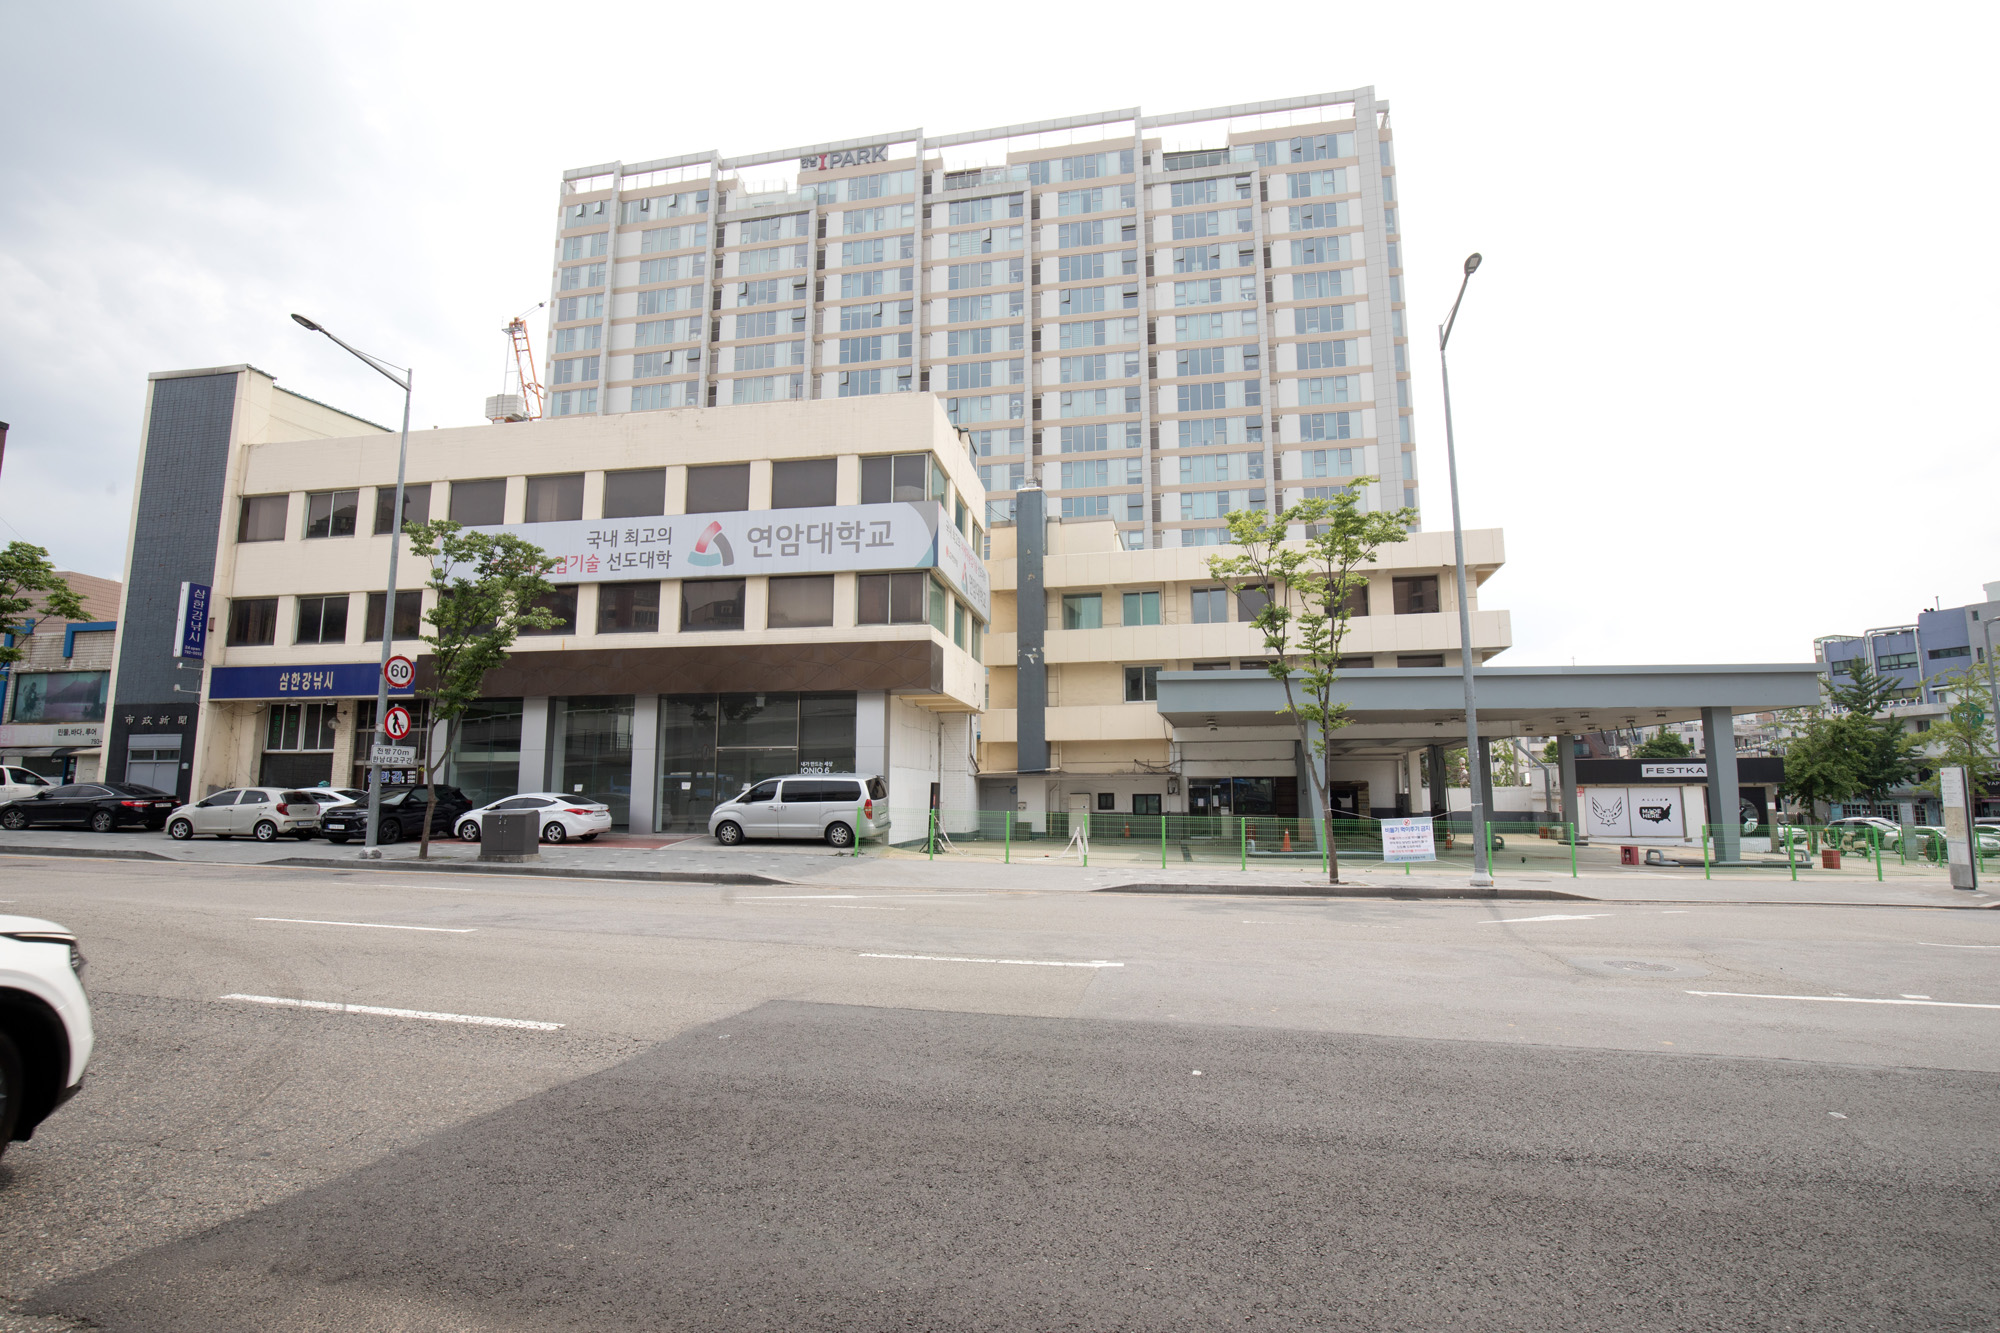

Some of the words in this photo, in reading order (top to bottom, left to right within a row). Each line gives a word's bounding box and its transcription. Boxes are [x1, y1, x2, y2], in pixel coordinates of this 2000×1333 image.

[586, 529, 618, 550] 국내
[623, 526, 673, 547] 최고의
[747, 520, 895, 558] 연암대학교
[606, 550, 673, 571] 선도대학
[188, 588, 207, 643] 삼한강낚시
[279, 671, 334, 691] 삼한강낚시
[390, 664, 409, 679] 60
[124, 714, 189, 726] 市政新聞
[1646, 767, 1705, 775] FESTKA
